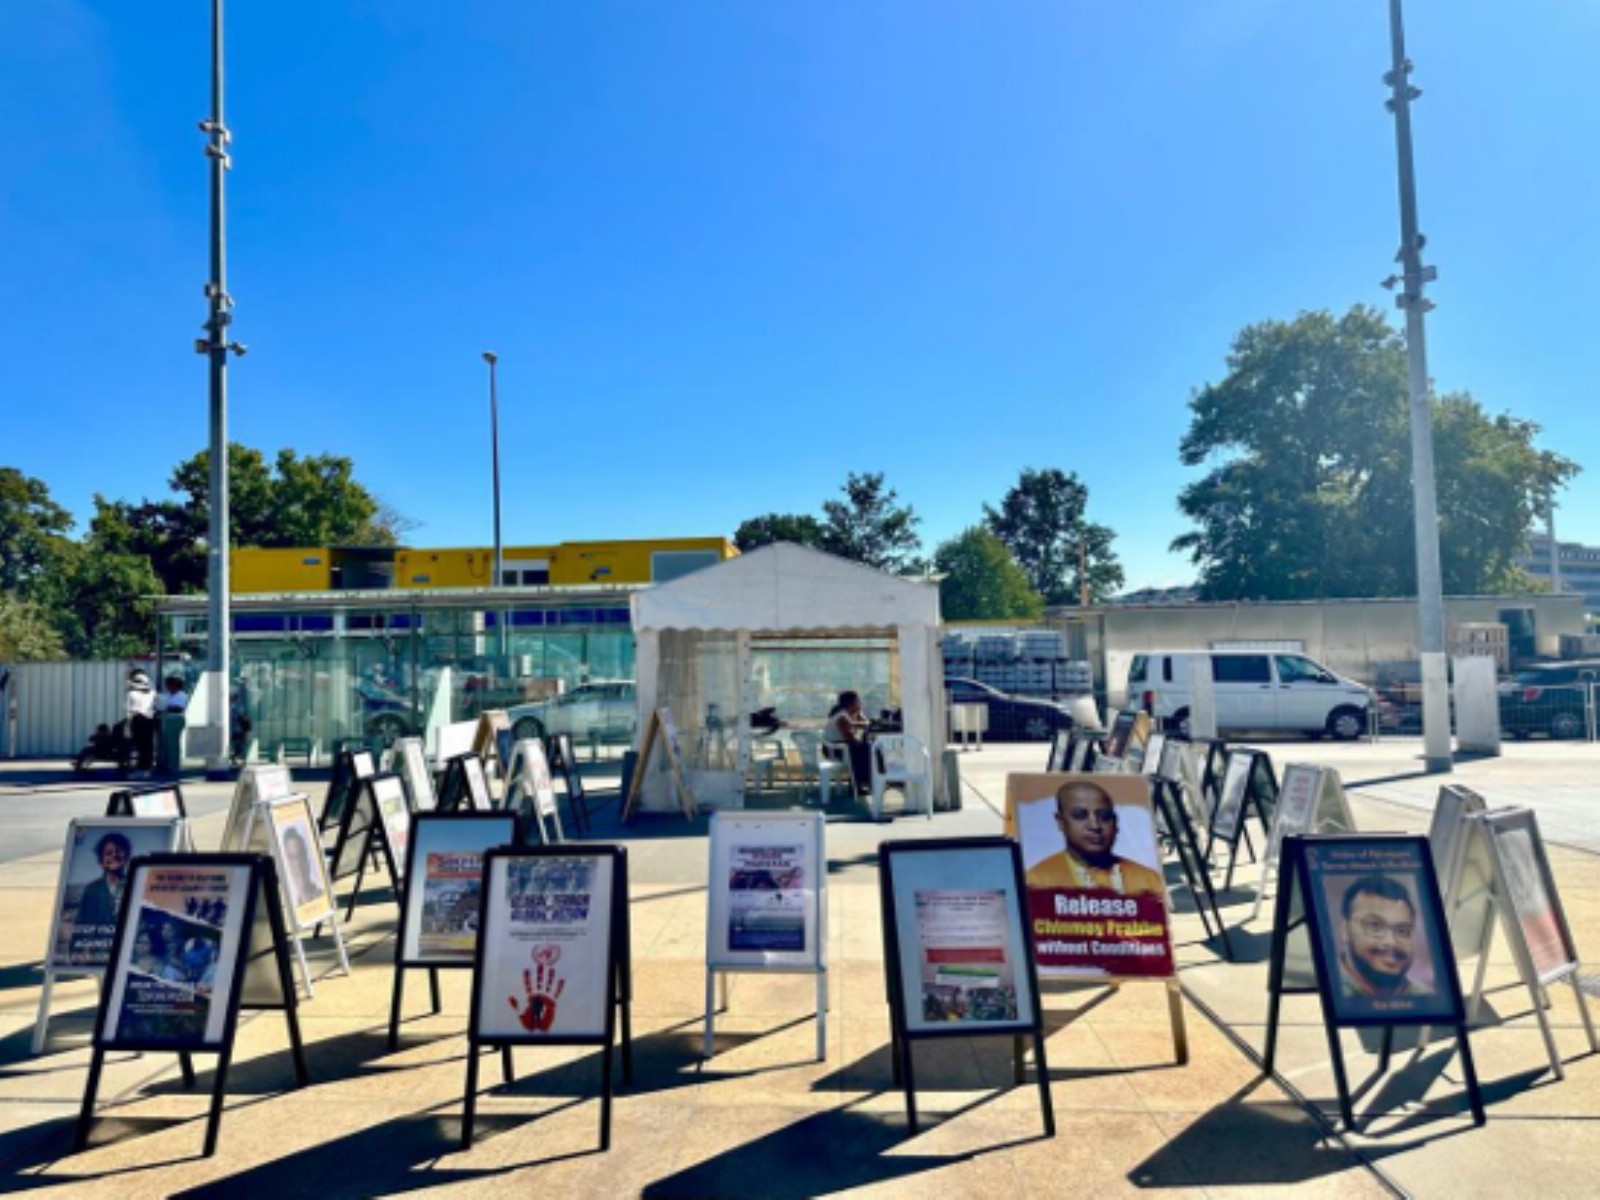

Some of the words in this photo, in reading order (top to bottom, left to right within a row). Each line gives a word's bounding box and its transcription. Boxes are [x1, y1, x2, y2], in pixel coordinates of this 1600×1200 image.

[1054, 893, 1138, 917] Release
[1036, 939, 1089, 956] without
[1091, 940, 1166, 956] Conditions
